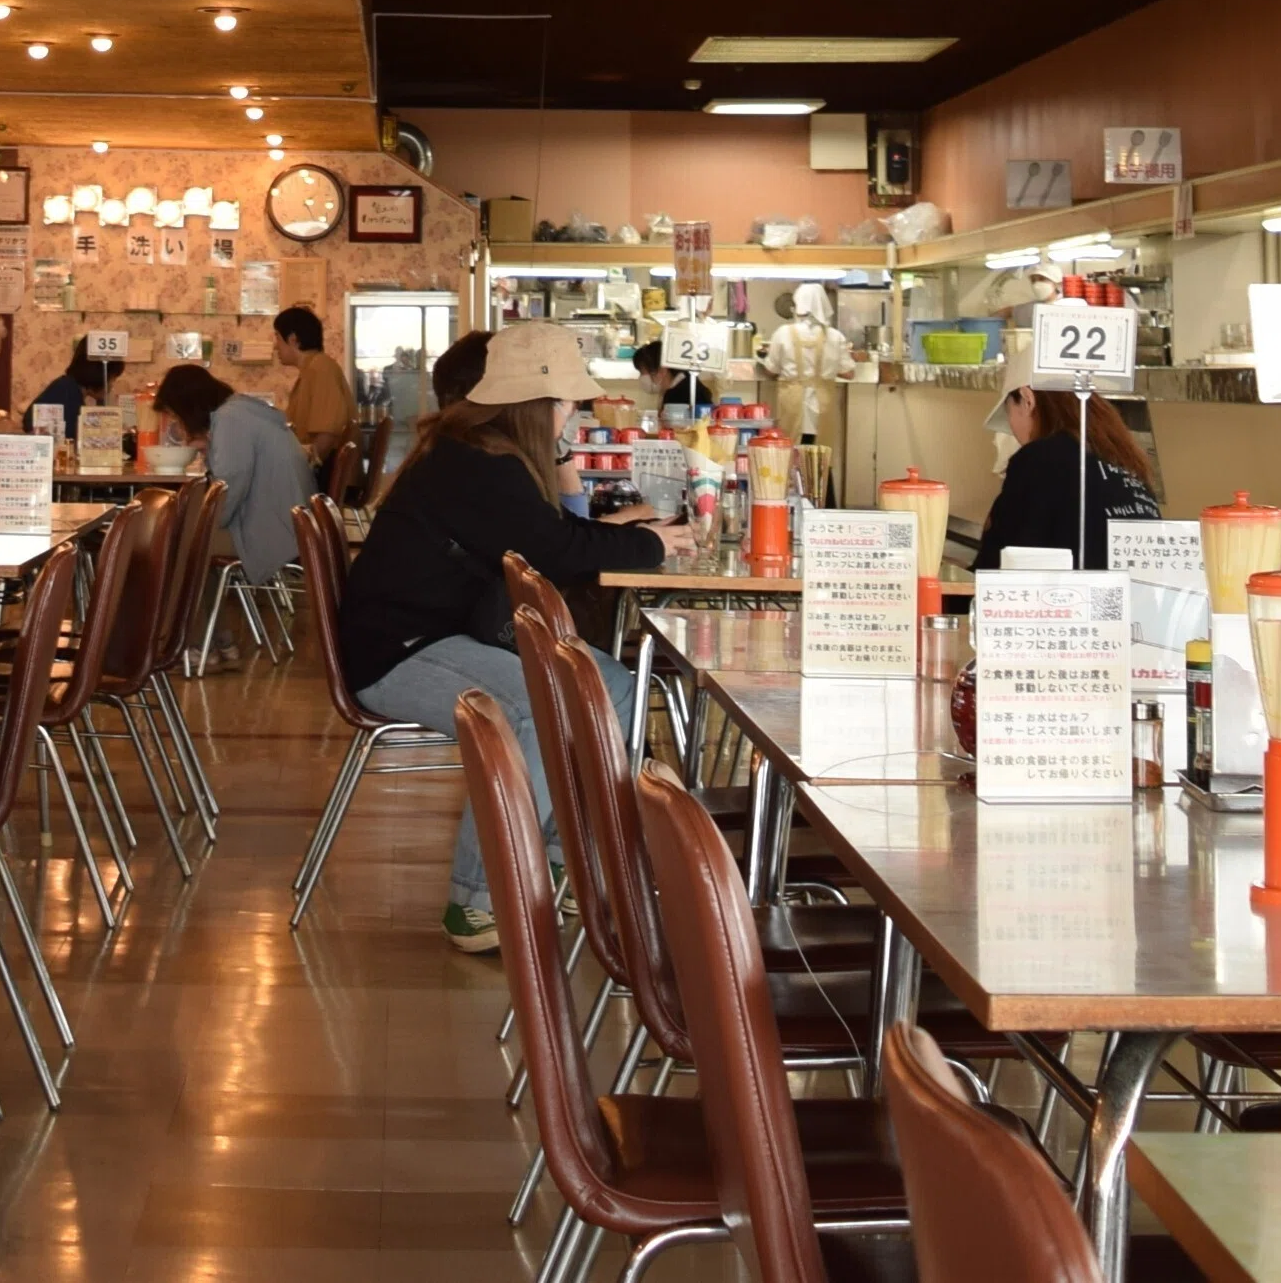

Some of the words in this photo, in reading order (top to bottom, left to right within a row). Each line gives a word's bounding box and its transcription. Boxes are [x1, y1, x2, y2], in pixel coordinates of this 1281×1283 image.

[97, 338, 118, 351] 35
[1059, 325, 1106, 361] 22
[680, 340, 711, 362] 23
[982, 590, 1040, 602] ようこそ！
[993, 640, 1122, 650] スタッフにお渡しください
[1015, 683, 1123, 693] 移動しないでください
[1005, 726, 1123, 736] サービスでお願いします
[1027, 769, 1123, 779] してお帰りください
